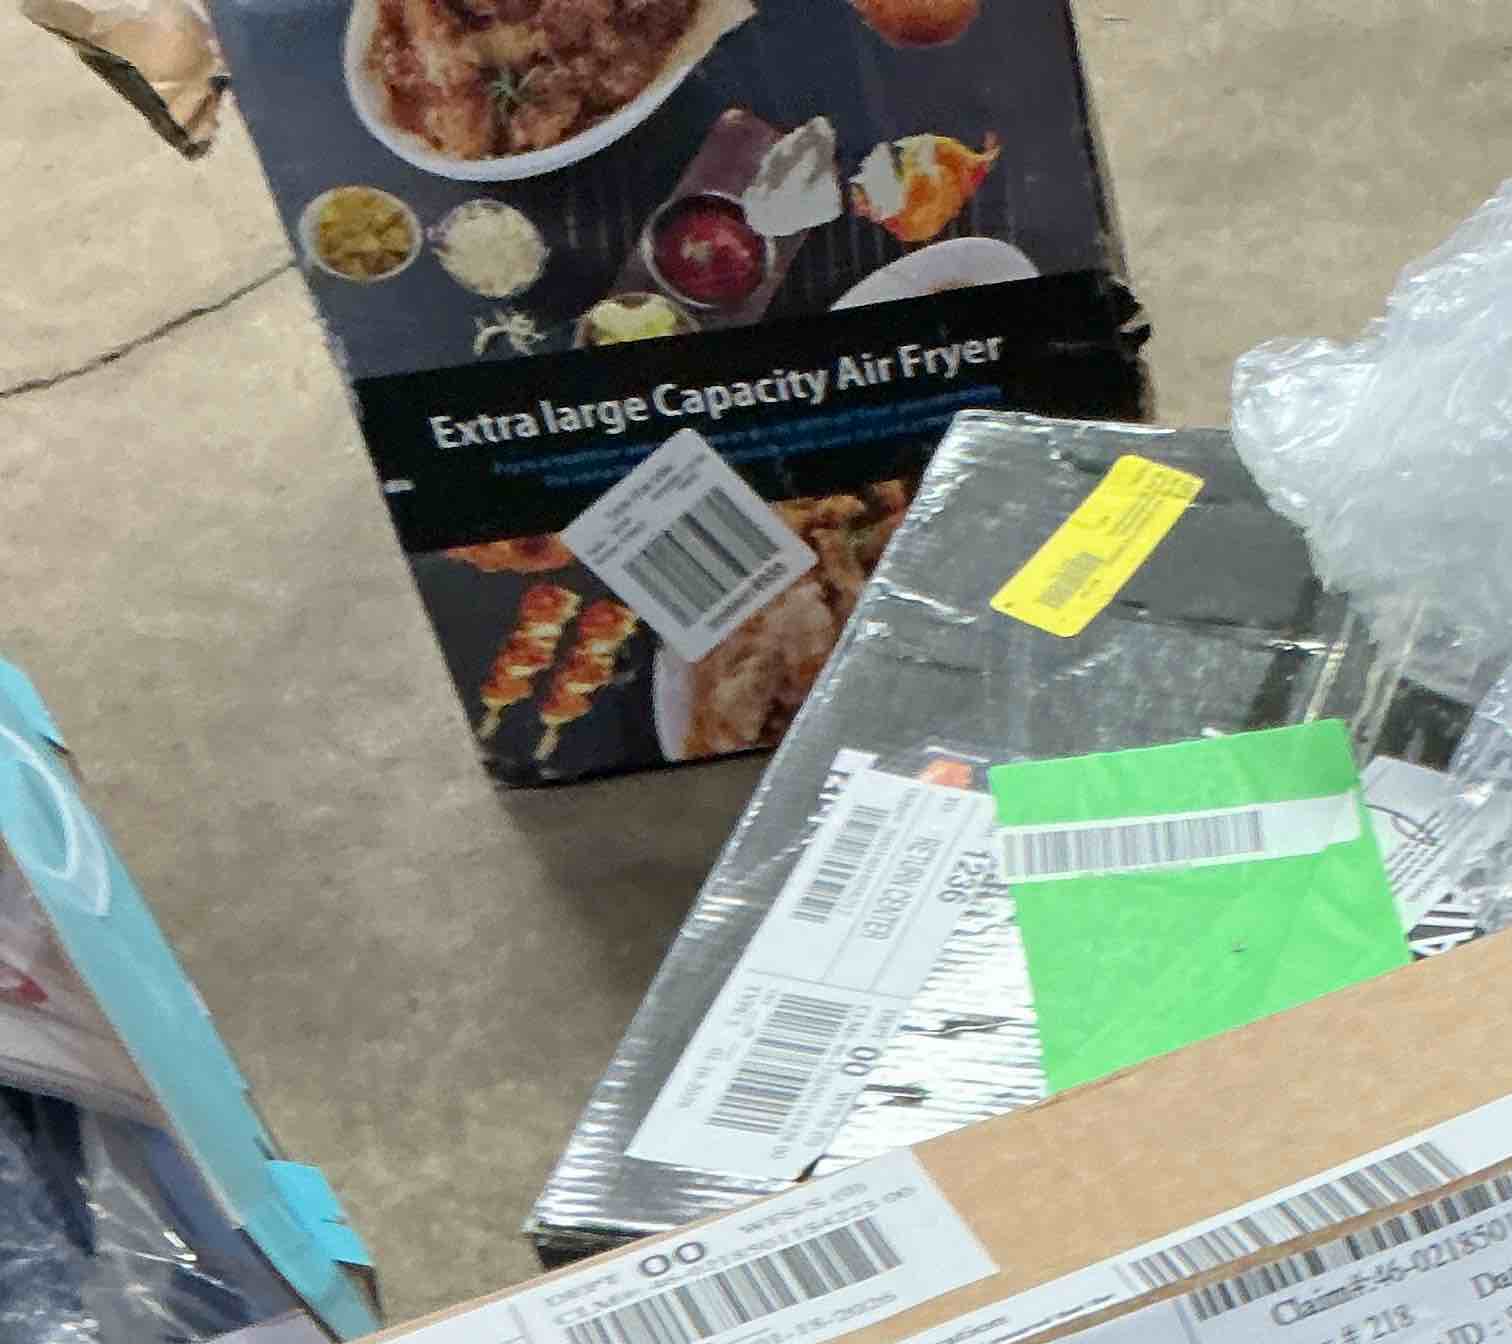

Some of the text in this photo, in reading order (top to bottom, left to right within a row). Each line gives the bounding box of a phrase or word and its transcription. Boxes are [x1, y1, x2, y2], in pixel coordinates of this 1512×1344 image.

[430, 336, 1001, 450] Extra large Capacity Air Fryer
[843, 1045, 881, 1077] 00
[638, 1241, 709, 1278] 00
[1364, 1304, 1416, 1340] 218
